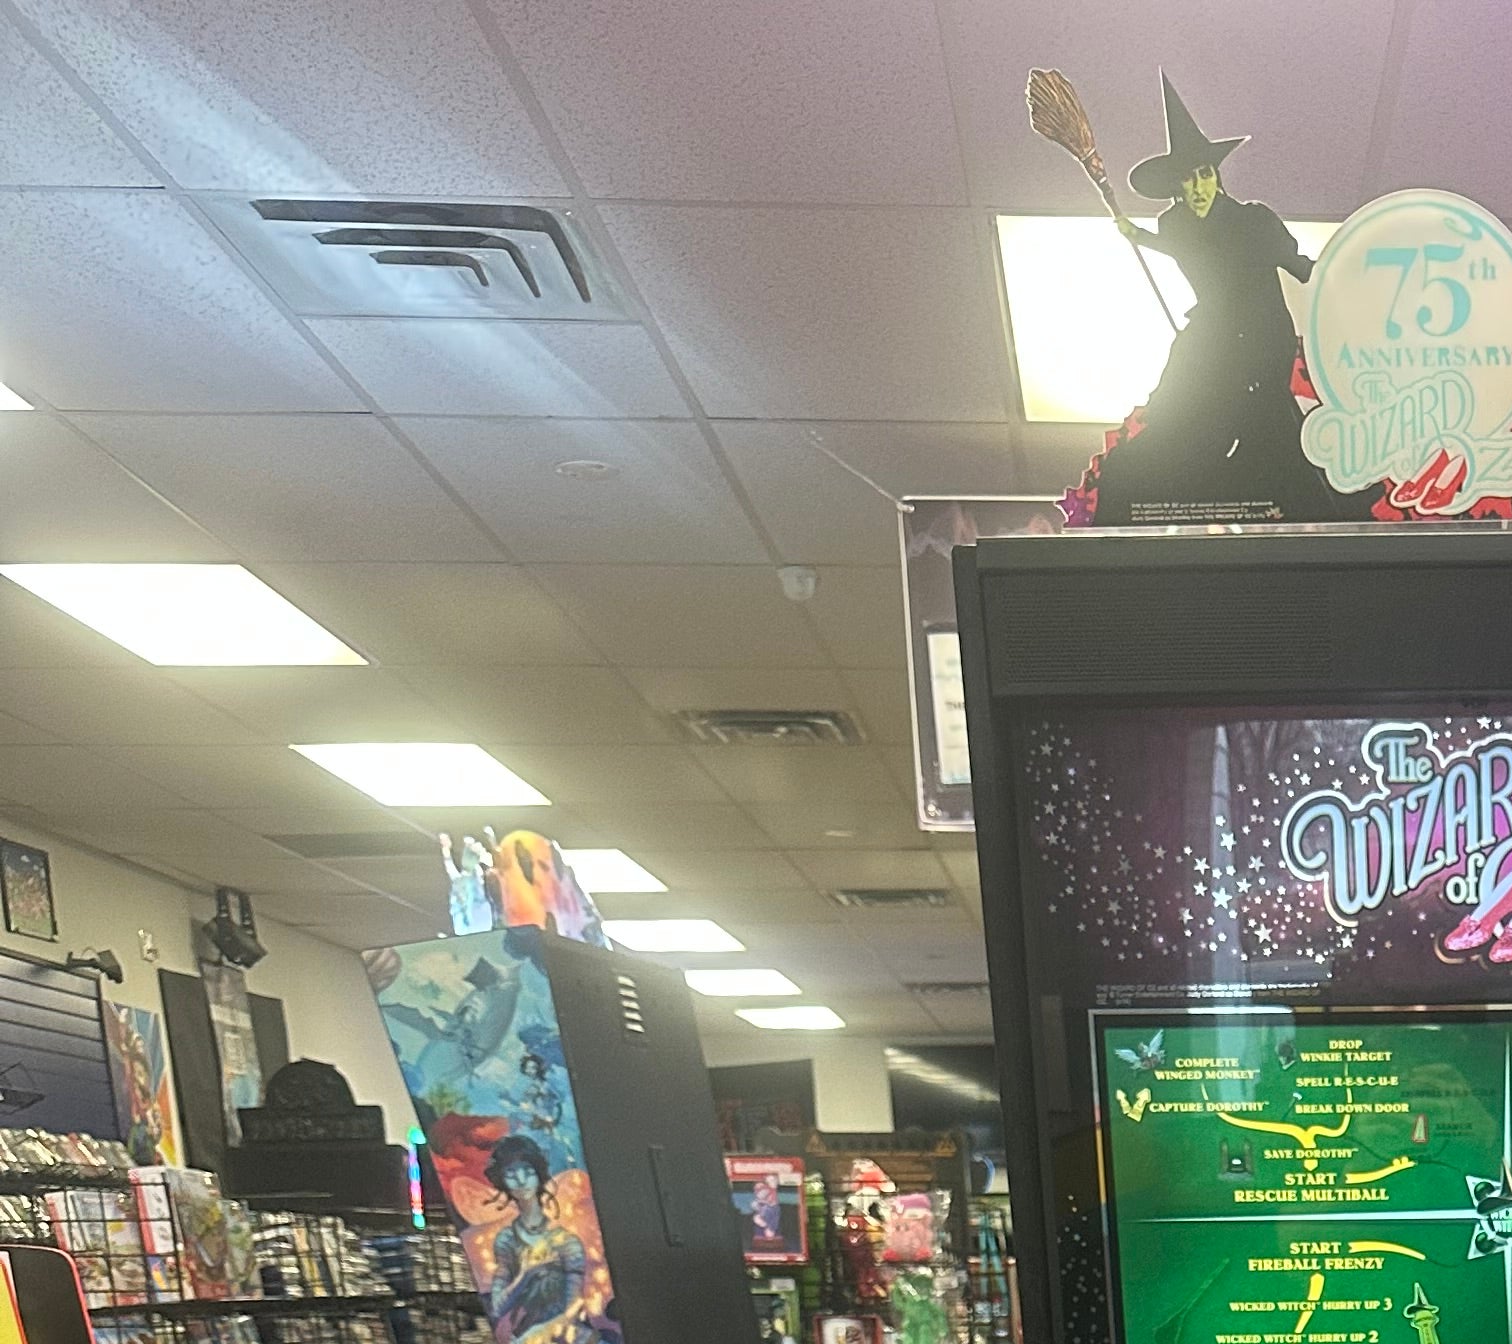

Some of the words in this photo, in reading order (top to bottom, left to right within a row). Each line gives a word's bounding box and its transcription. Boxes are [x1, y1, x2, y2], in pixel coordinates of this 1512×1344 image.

[1363, 244, 1496, 340] 75th
[1316, 379, 1467, 478] WIZARD
[1371, 735, 1432, 784] The
[1445, 852, 1487, 905] of
[1329, 1040, 1363, 1050] DROP
[1300, 1052, 1343, 1062] WINKIE
[1345, 1051, 1392, 1062] TARGET
[1175, 1058, 1239, 1068] COMPLETE
[1155, 1070, 1202, 1080] WINGED
[1296, 1077, 1331, 1087] SPELL
[1149, 1102, 1203, 1113] CAPTURE
[1206, 1101, 1267, 1112] DOROTHY
[1295, 1104, 1335, 1114] BREAK
[1338, 1103, 1374, 1113] DOWN
[1376, 1102, 1409, 1113] DOOR
[1264, 1150, 1293, 1159] SAVE
[1284, 1173, 1337, 1186] START
[1234, 1190, 1298, 1202] RESCUE
[1301, 1189, 1389, 1201] MULTIBALL
[1290, 1242, 1341, 1254] START
[1248, 1259, 1322, 1271] FIREBALL
[1325, 1258, 1385, 1270] FRENZY
[1229, 1301, 1275, 1311] WICKED
[1278, 1301, 1317, 1311] WITCH
[1323, 1300, 1362, 1310] HURRY
[1364, 1300, 1380, 1310] UP
[1382, 1298, 1392, 1310] 3
[1216, 1334, 1262, 1344] WICKED
[1264, 1334, 1303, 1344] WITCH
[1308, 1333, 1347, 1343] HURRY
[1350, 1333, 1366, 1343] UP
[1368, 1331, 1379, 1343] 2
